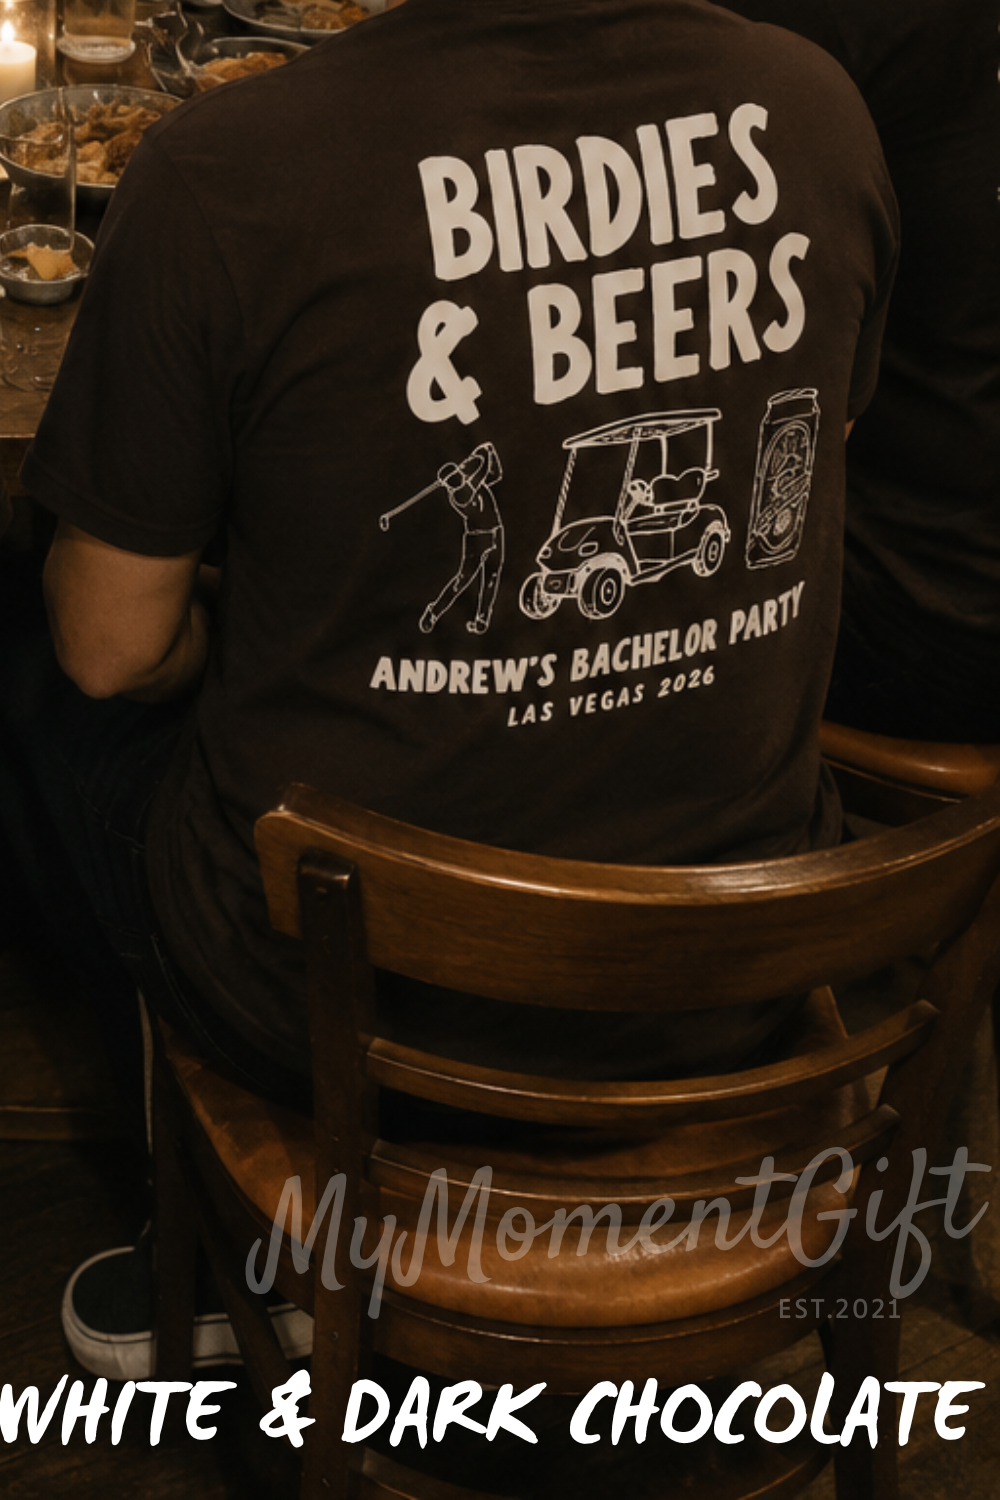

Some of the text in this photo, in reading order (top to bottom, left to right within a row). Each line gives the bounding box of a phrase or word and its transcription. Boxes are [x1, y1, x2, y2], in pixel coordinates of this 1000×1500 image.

[417, 102, 779, 282] BIRDIES
[406, 231, 811, 425] & BEERS
[369, 580, 806, 695] ANDREW'S BACHELOR PARTY
[507, 665, 715, 728] LAS VEGAS 2026
